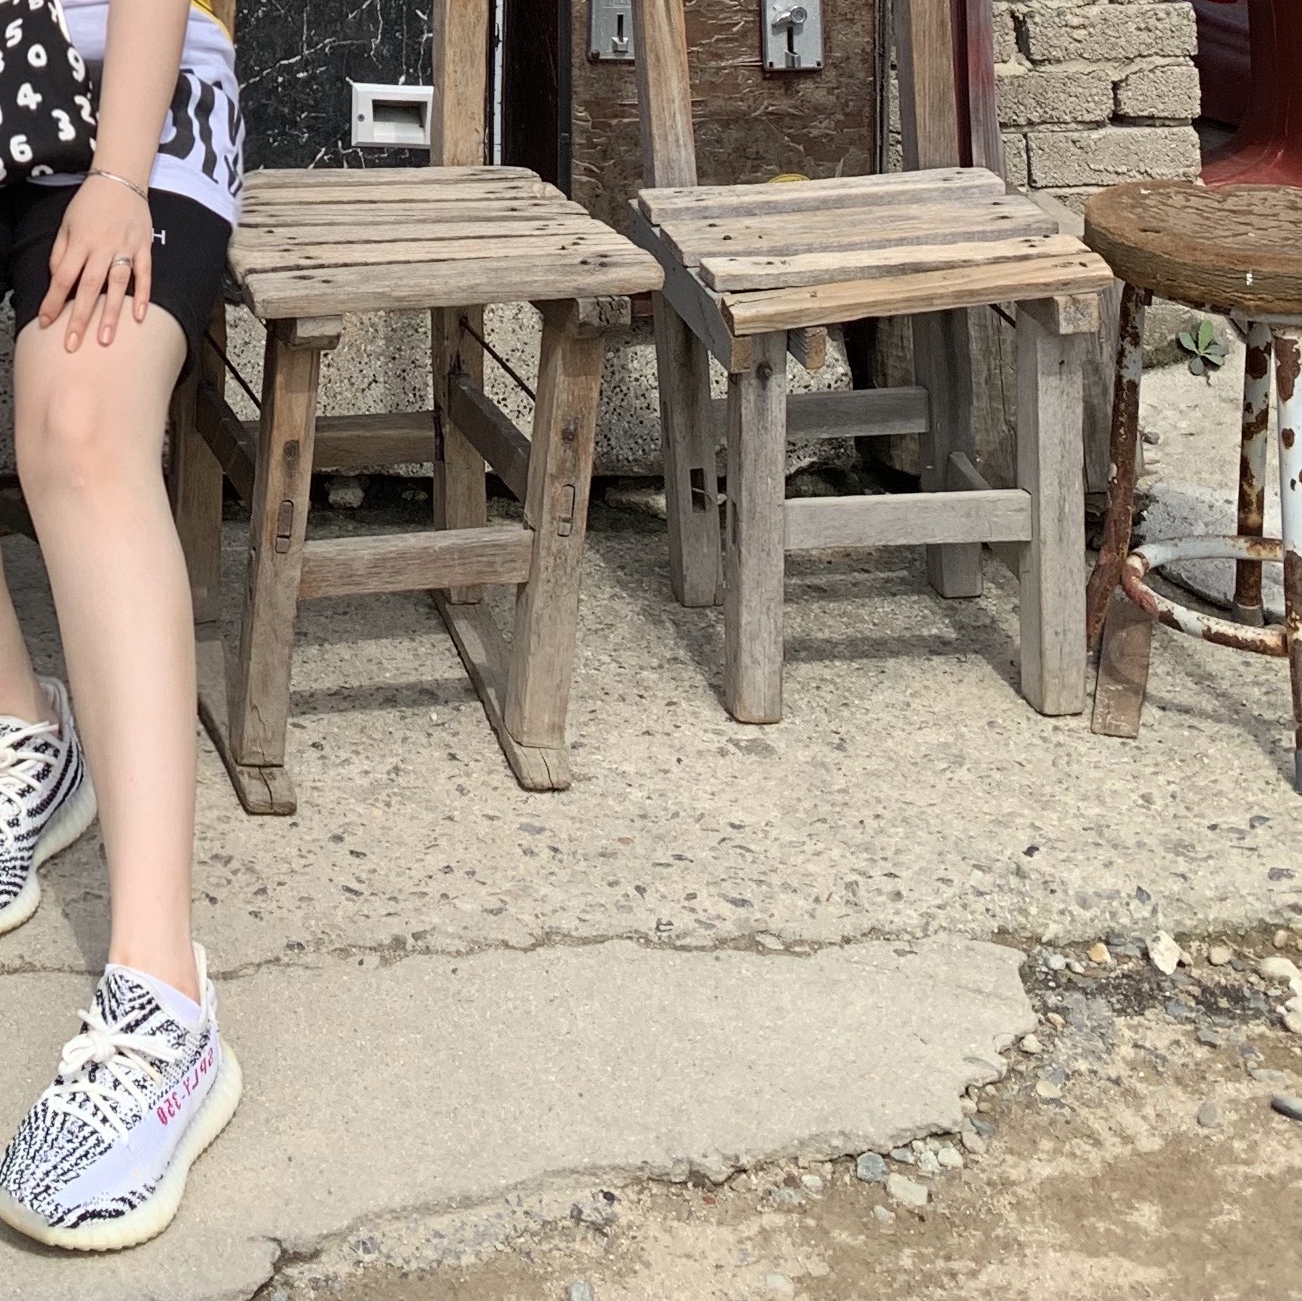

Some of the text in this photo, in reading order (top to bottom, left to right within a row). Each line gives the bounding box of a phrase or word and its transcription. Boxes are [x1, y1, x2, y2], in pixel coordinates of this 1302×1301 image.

[4, 18, 23, 48] 5
[16, 82, 43, 110] 4
[51, 108, 76, 141] 3
[9, 134, 33, 163] 6
